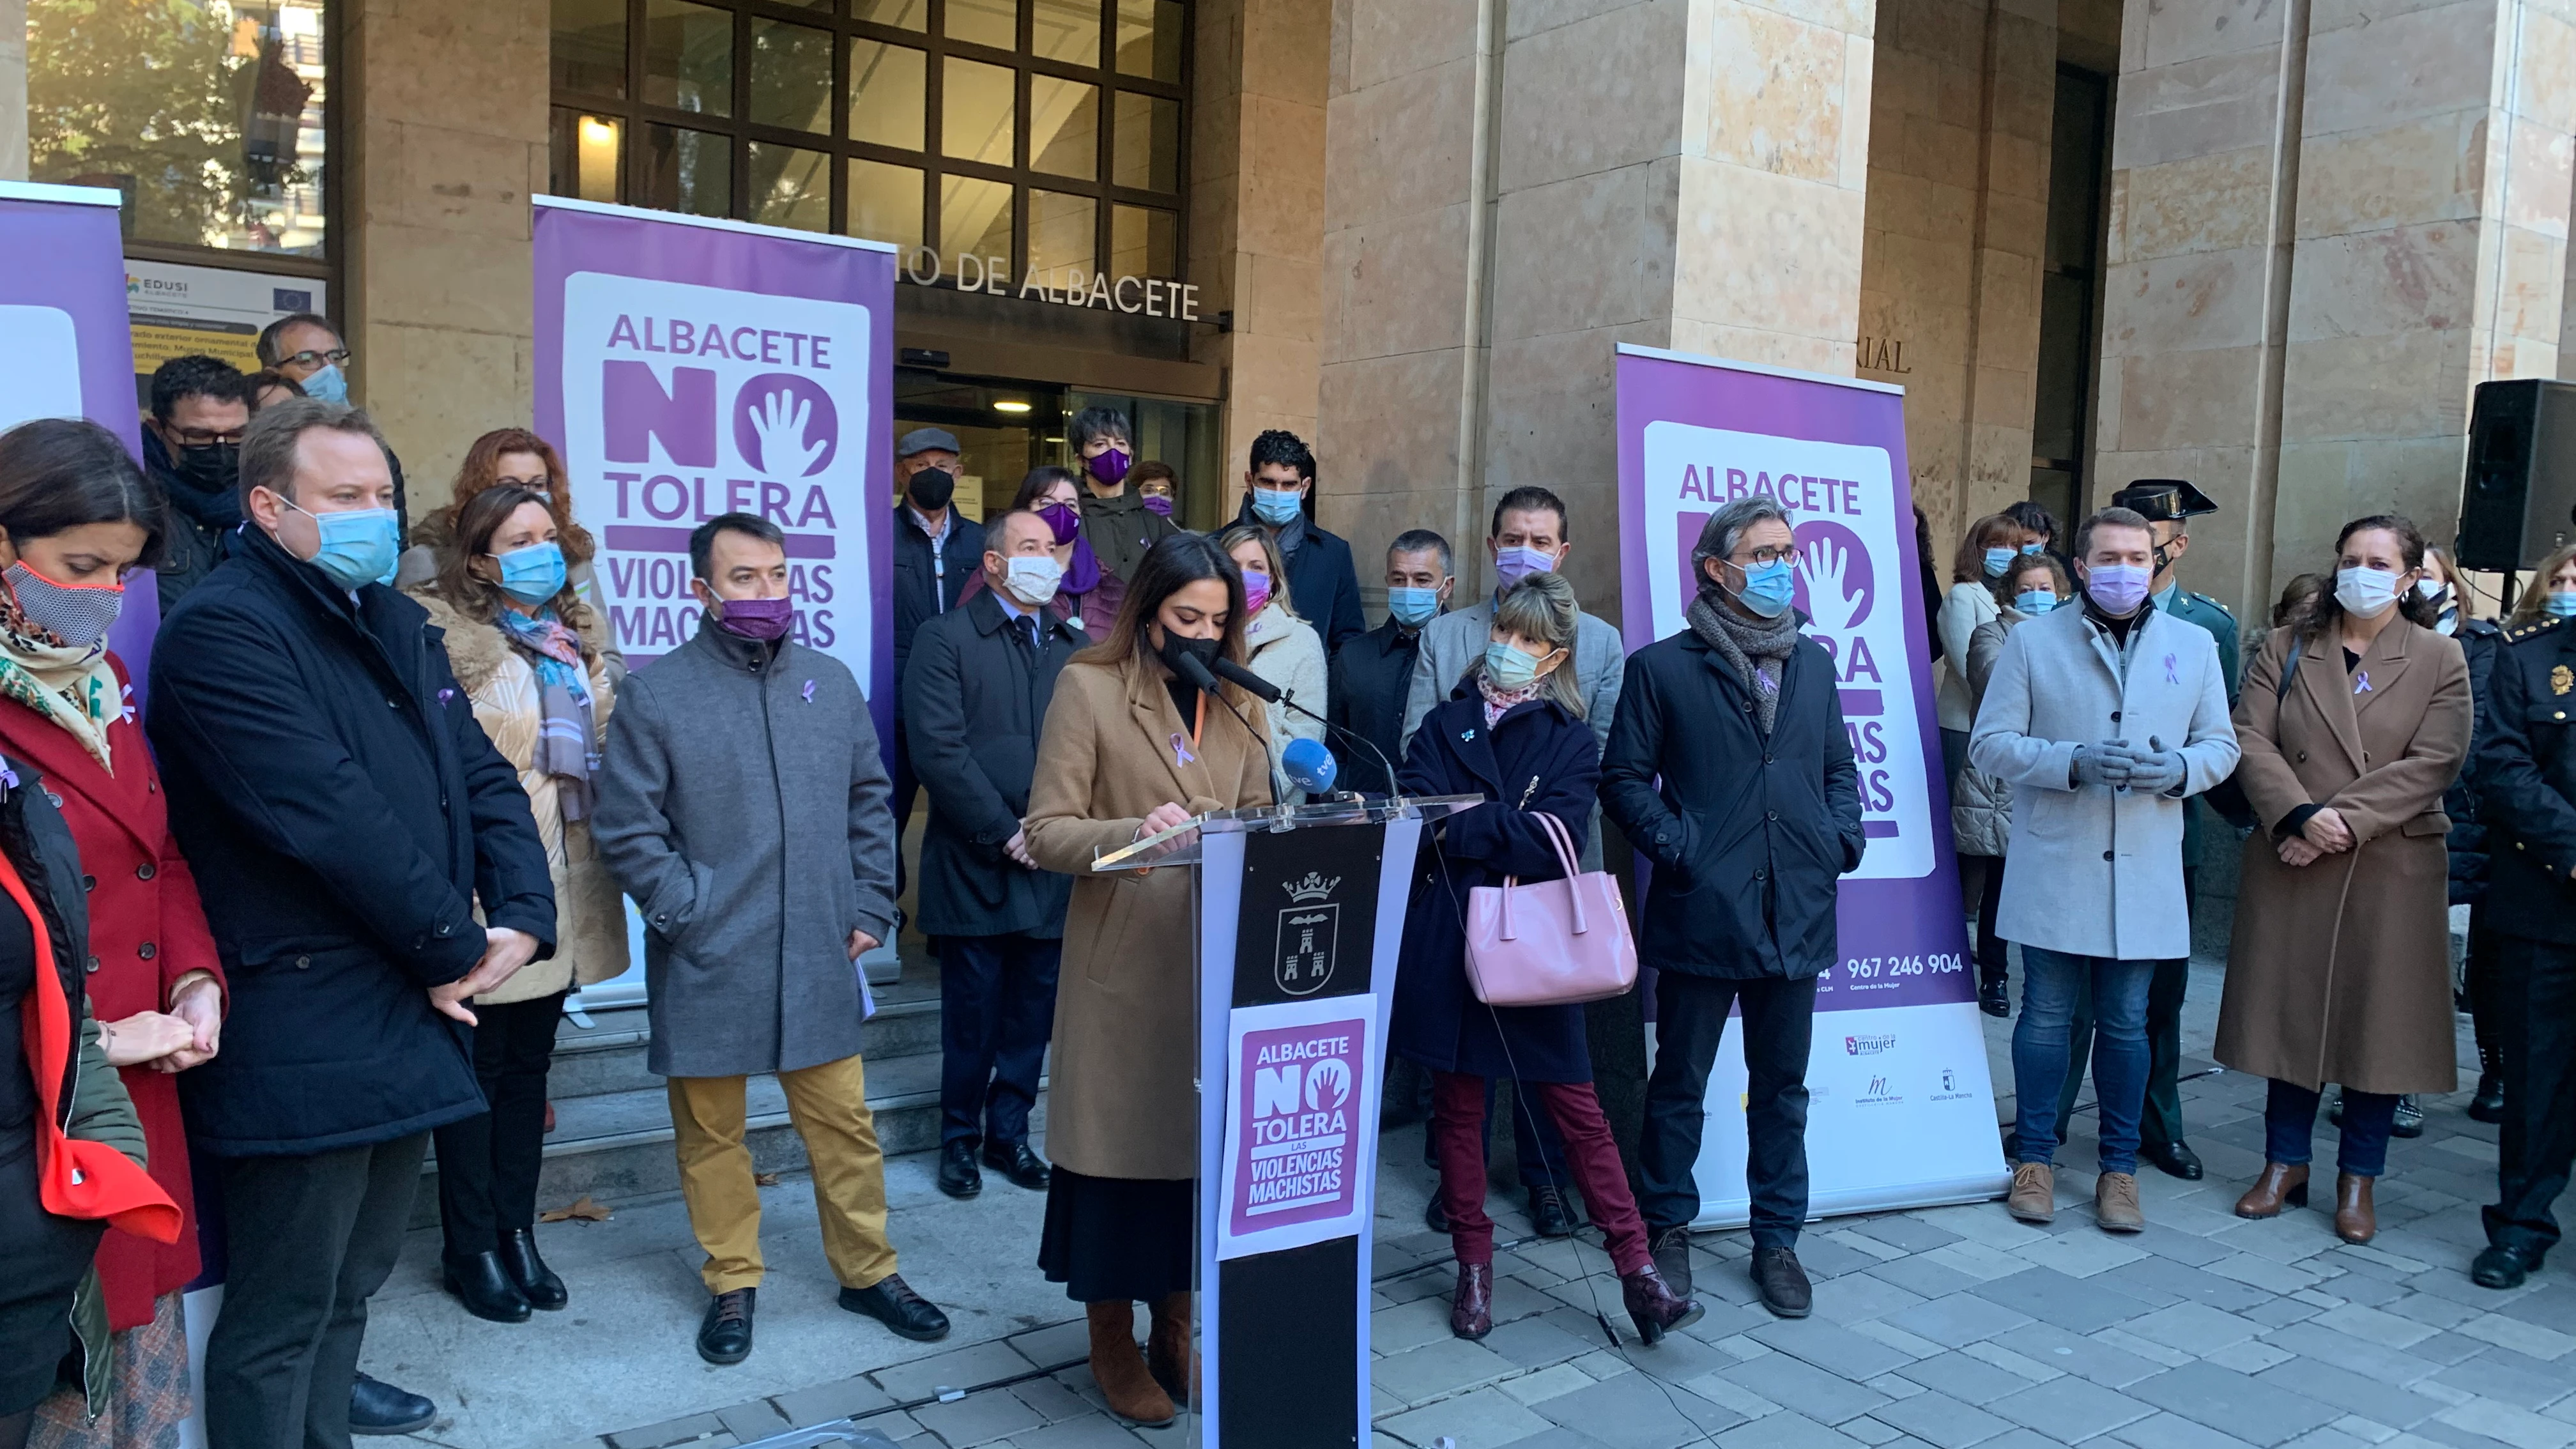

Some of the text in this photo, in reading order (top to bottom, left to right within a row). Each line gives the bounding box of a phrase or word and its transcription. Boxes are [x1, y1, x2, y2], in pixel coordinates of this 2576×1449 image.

[144, 279, 188, 292] EDUSI
[957, 252, 1006, 296] DE
[1019, 263, 1199, 321] ALBACETE
[155, 333, 192, 342] exterior
[194, 336, 248, 347] ornamental
[208, 348, 254, 358] Municipal
[606, 314, 831, 370] ALBACETE
[1856, 336, 1912, 374] IAL
[602, 359, 839, 477] NO
[603, 471, 837, 529] TOLERA
[1679, 464, 1862, 516] ALBACETE
[1317, 754, 1334, 776] tve
[1848, 957, 1881, 978] 967
[1888, 955, 1923, 976] 246
[1928, 953, 1963, 974] 904
[1884, 982, 1900, 990] Mujer
[1257, 1036, 1349, 1065] ALBACETE
[1859, 1037, 1896, 1053] mujer
[1254, 1058, 1351, 1119] NO
[1252, 1110, 1347, 1145] TOLERA
[1291, 1142, 1307, 1151] LAS
[1251, 1148, 1342, 1182] VIOLENCIAS
[1248, 1169, 1341, 1204] MACHISTAS
